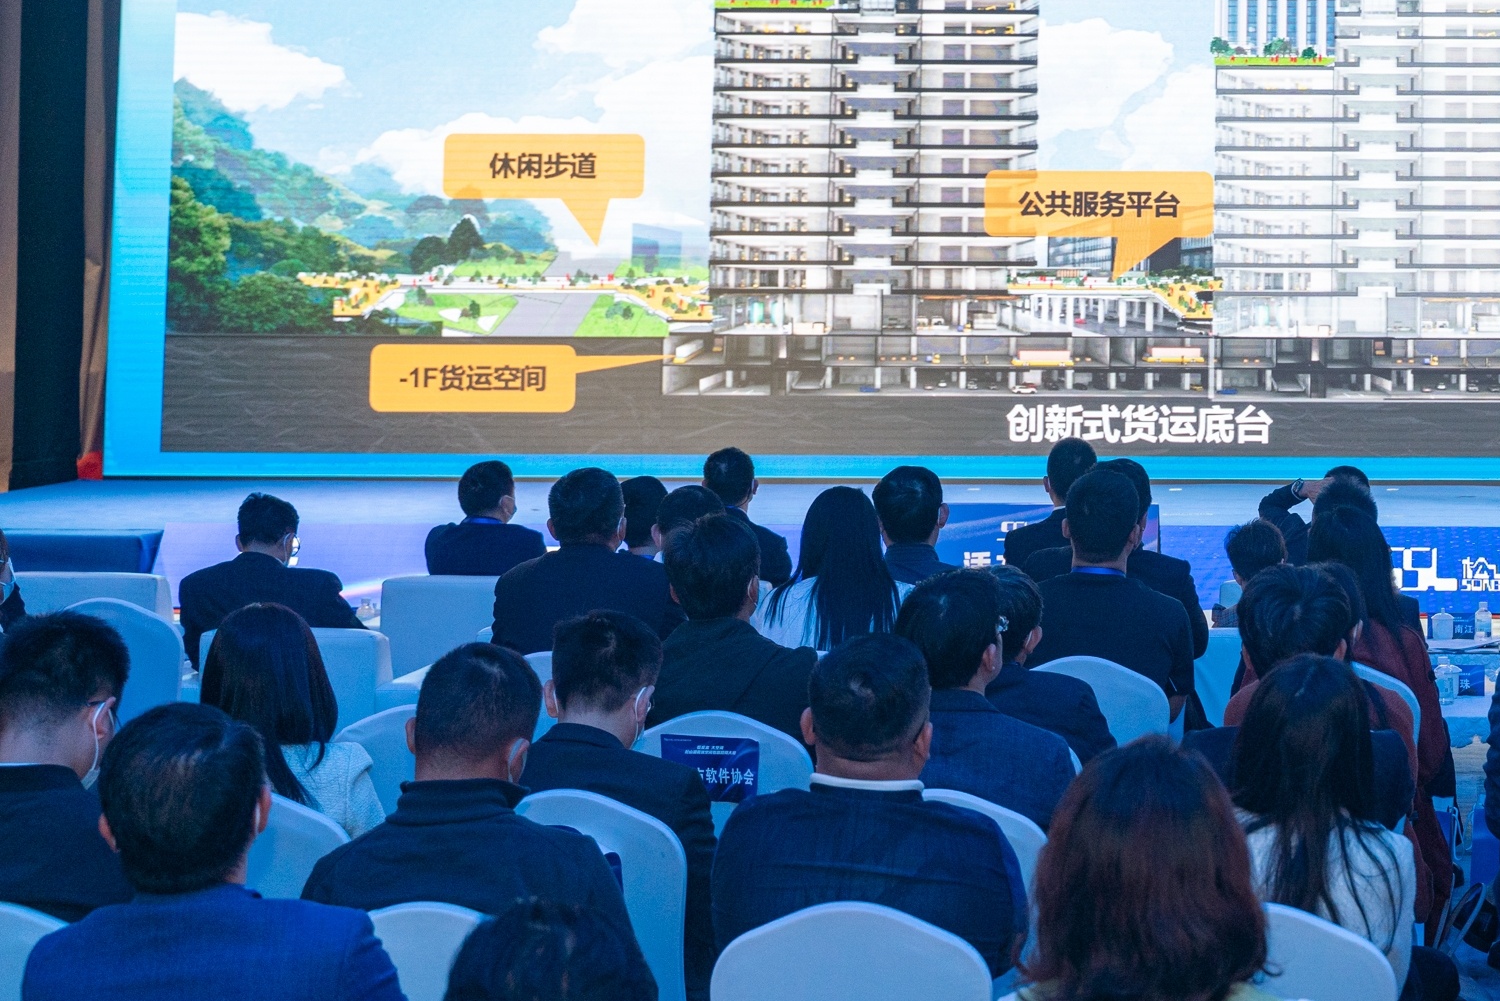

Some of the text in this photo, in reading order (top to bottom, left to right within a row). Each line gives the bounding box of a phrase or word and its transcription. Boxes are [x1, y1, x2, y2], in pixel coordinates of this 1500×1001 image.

[489, 151, 598, 181] 休闲步道
[1018, 188, 1181, 219] 公共服务平台
[399, 363, 547, 394] -1F货运空间
[1005, 402, 1273, 445] 创新式货运底台
